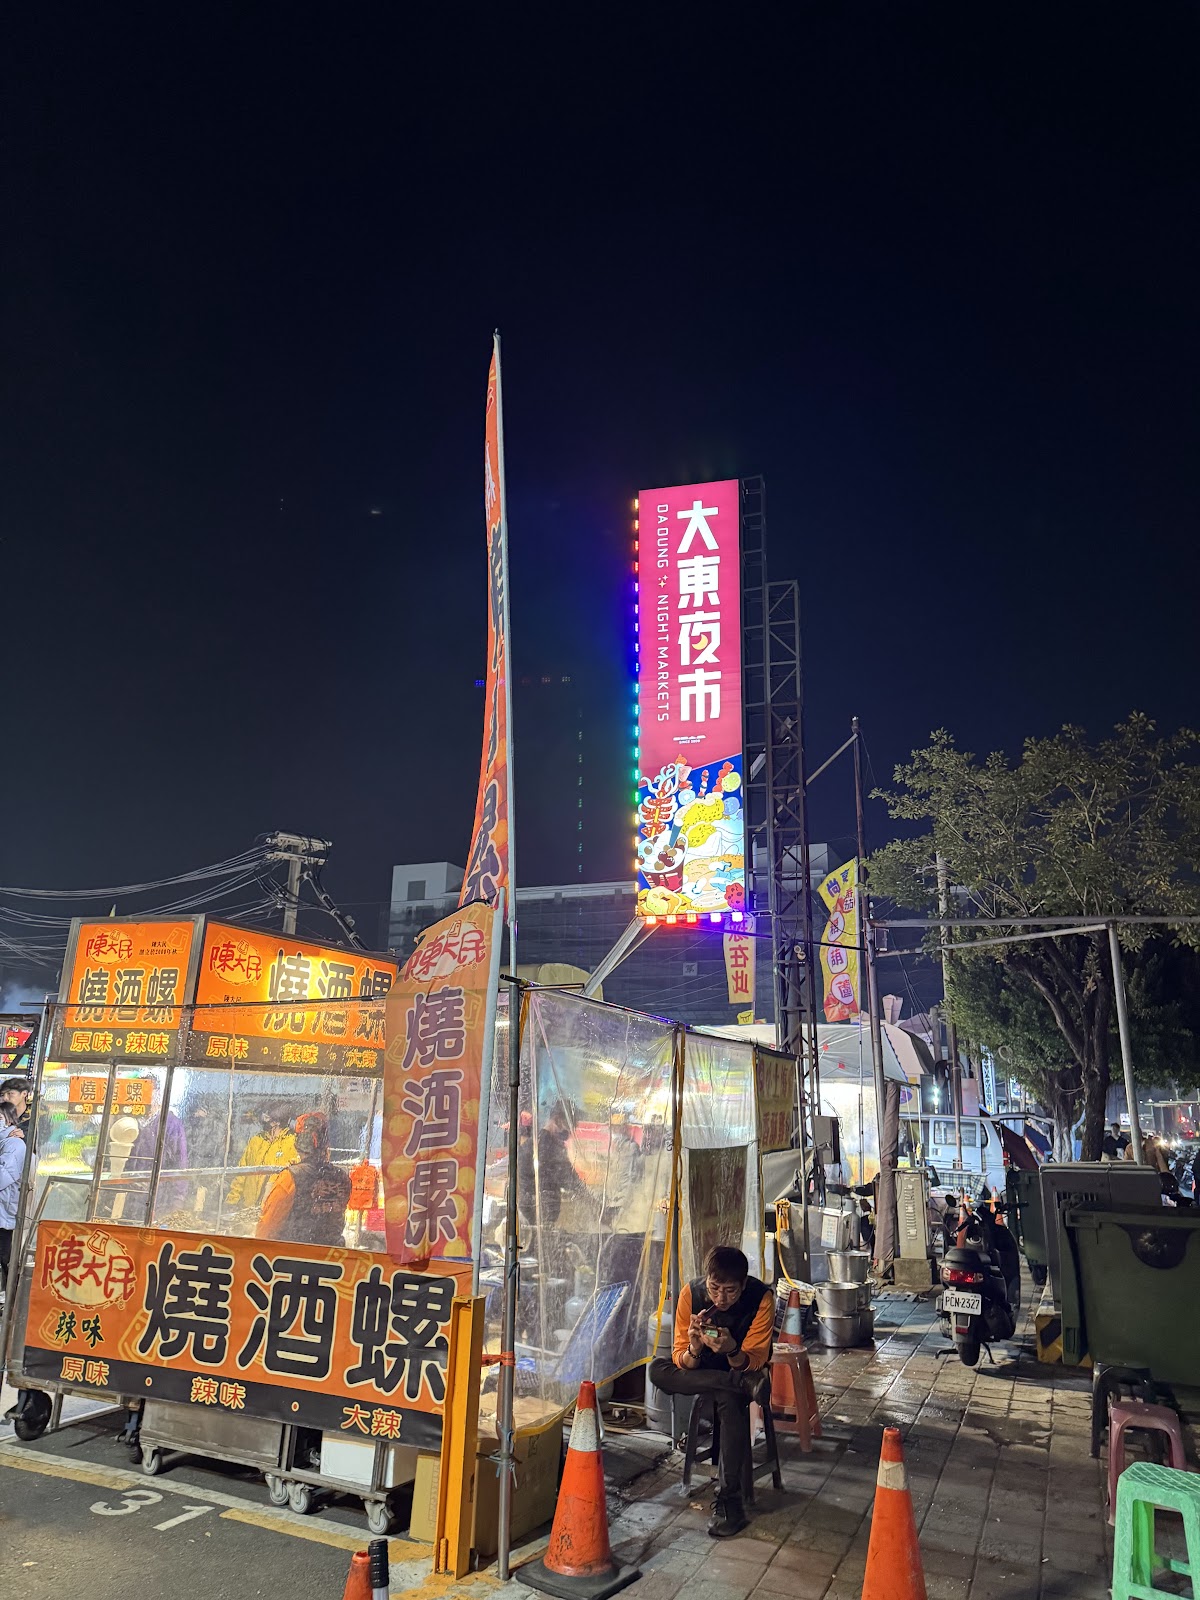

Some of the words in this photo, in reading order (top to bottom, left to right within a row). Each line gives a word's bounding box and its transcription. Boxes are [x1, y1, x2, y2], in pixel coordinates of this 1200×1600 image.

[657, 504, 669, 524] DA
[657, 527, 669, 568] DUNG
[657, 594, 669, 642] NIGHT
[677, 500, 721, 722] 大東夜市
[657, 648, 669, 721] MARKETS
[86, 932, 133, 959] 陳大民
[209, 941, 263, 981] 陳大民
[404, 929, 486, 983] 陳大民
[74, 967, 179, 1023] 燒酒螺
[263, 948, 392, 1043] 燒酒螺
[206, 1036, 249, 1059] 原味
[41, 1234, 137, 1301] 陳大民
[136, 1239, 456, 1405] 燒酒螺
[945, 1296, 980, 1310] PCN-2327
[54, 1311, 105, 1350] 辣味
[61, 1356, 110, 1386] 原味
[190, 1377, 246, 1410] 辣味
[340, 1405, 402, 1440] 大辣
